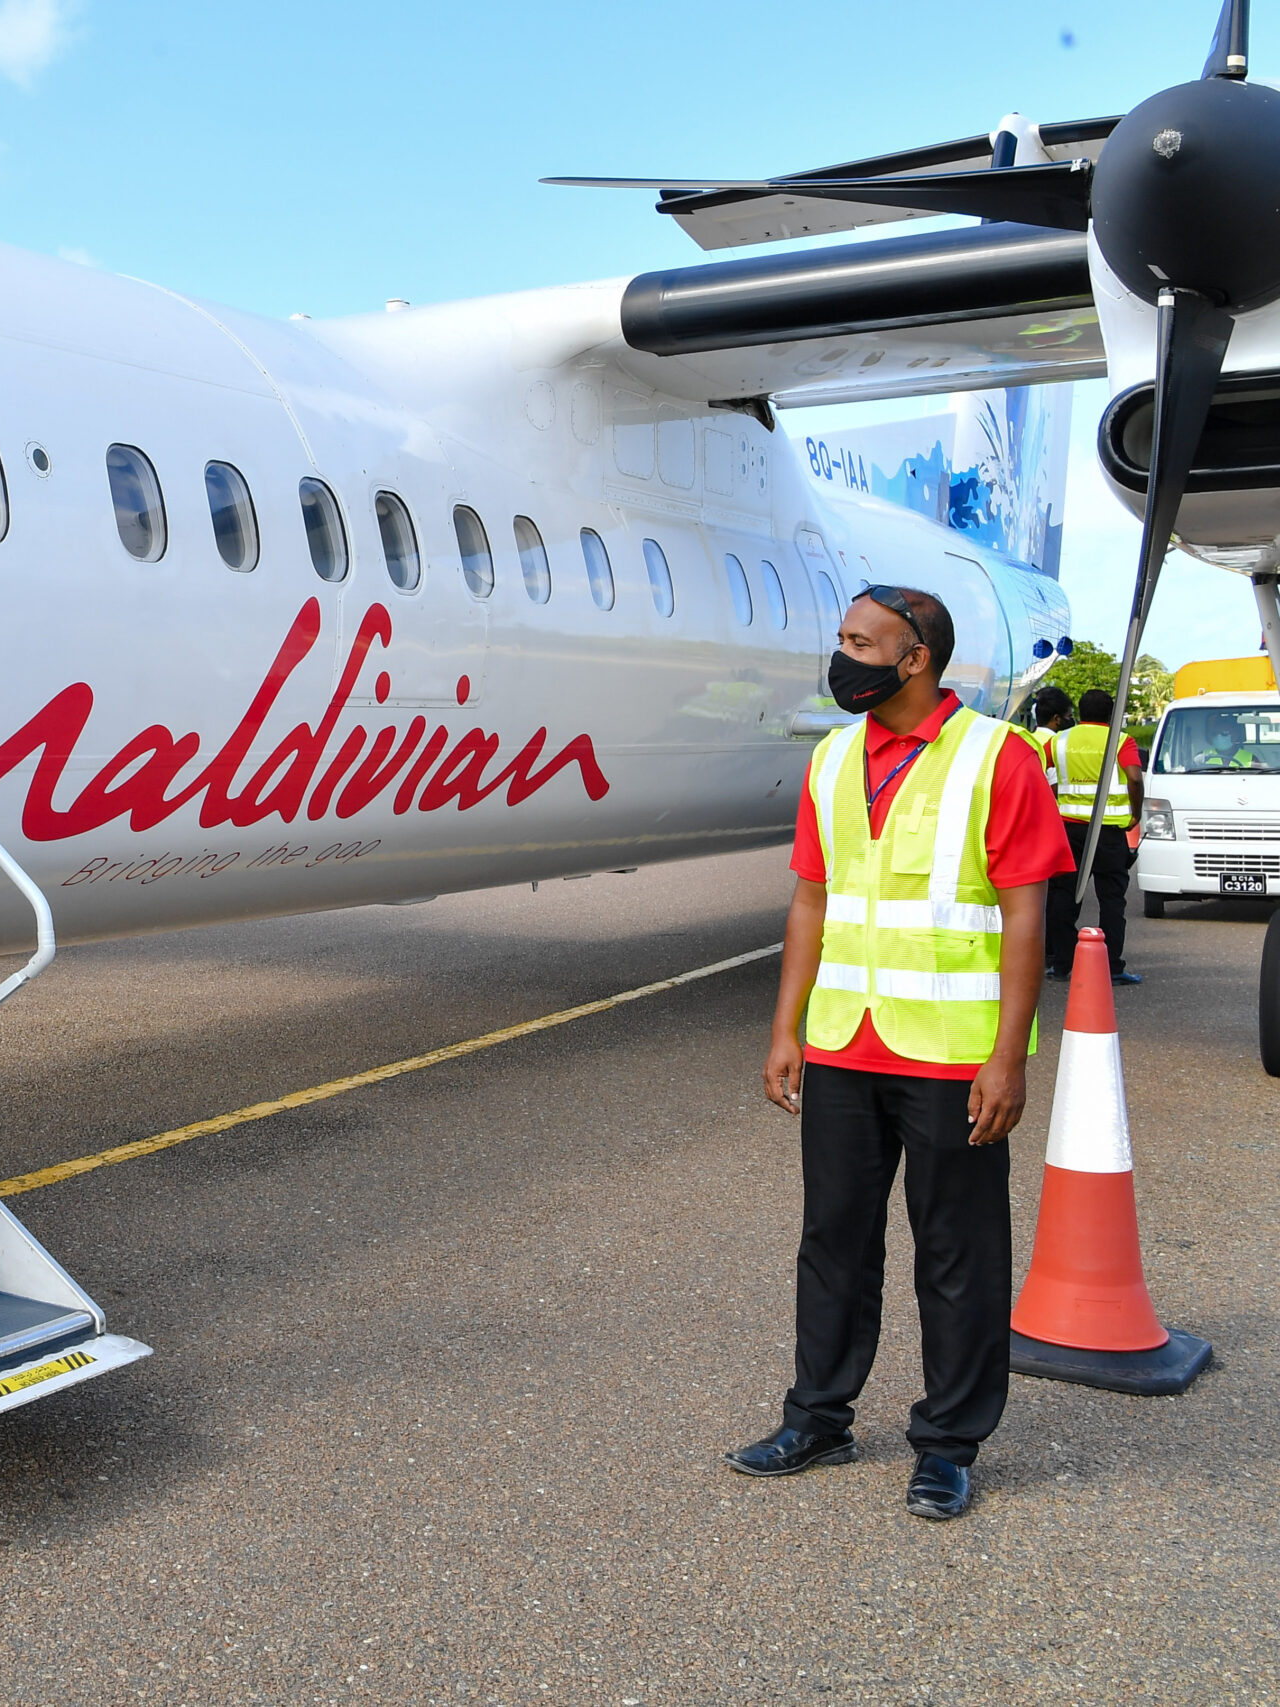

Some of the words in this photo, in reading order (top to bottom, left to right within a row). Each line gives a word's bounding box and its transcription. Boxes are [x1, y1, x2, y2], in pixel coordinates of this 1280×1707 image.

[806, 437, 869, 493] 8Q-IAA
[61, 848, 240, 886] Bridging
[246, 841, 308, 868] the
[305, 839, 382, 868] gap
[1224, 881, 1262, 891] C3120
